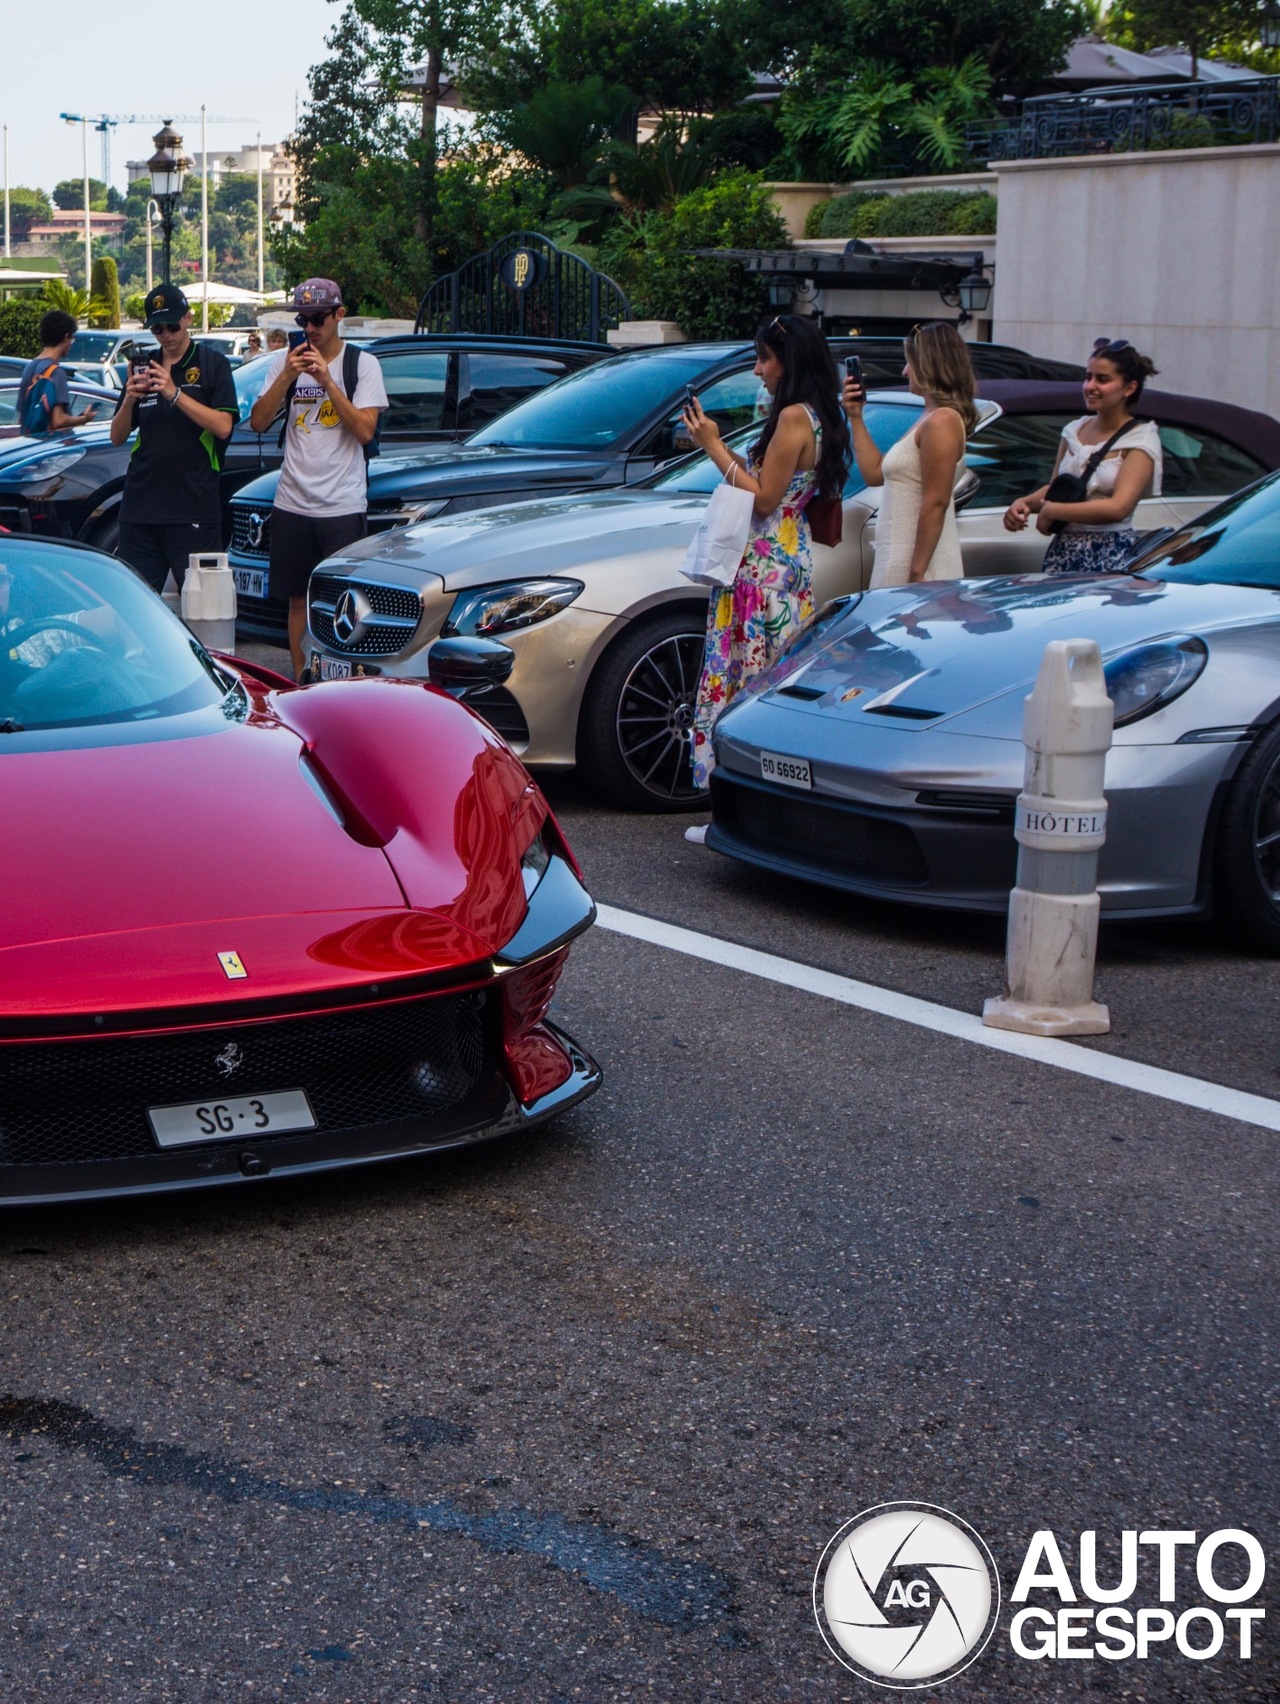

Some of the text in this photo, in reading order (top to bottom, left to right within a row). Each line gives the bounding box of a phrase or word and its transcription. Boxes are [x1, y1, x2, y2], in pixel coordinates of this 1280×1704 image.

[294, 387, 324, 398] AKERS
[777, 761, 810, 782] 56922
[1026, 812, 1101, 833] HÔTEL
